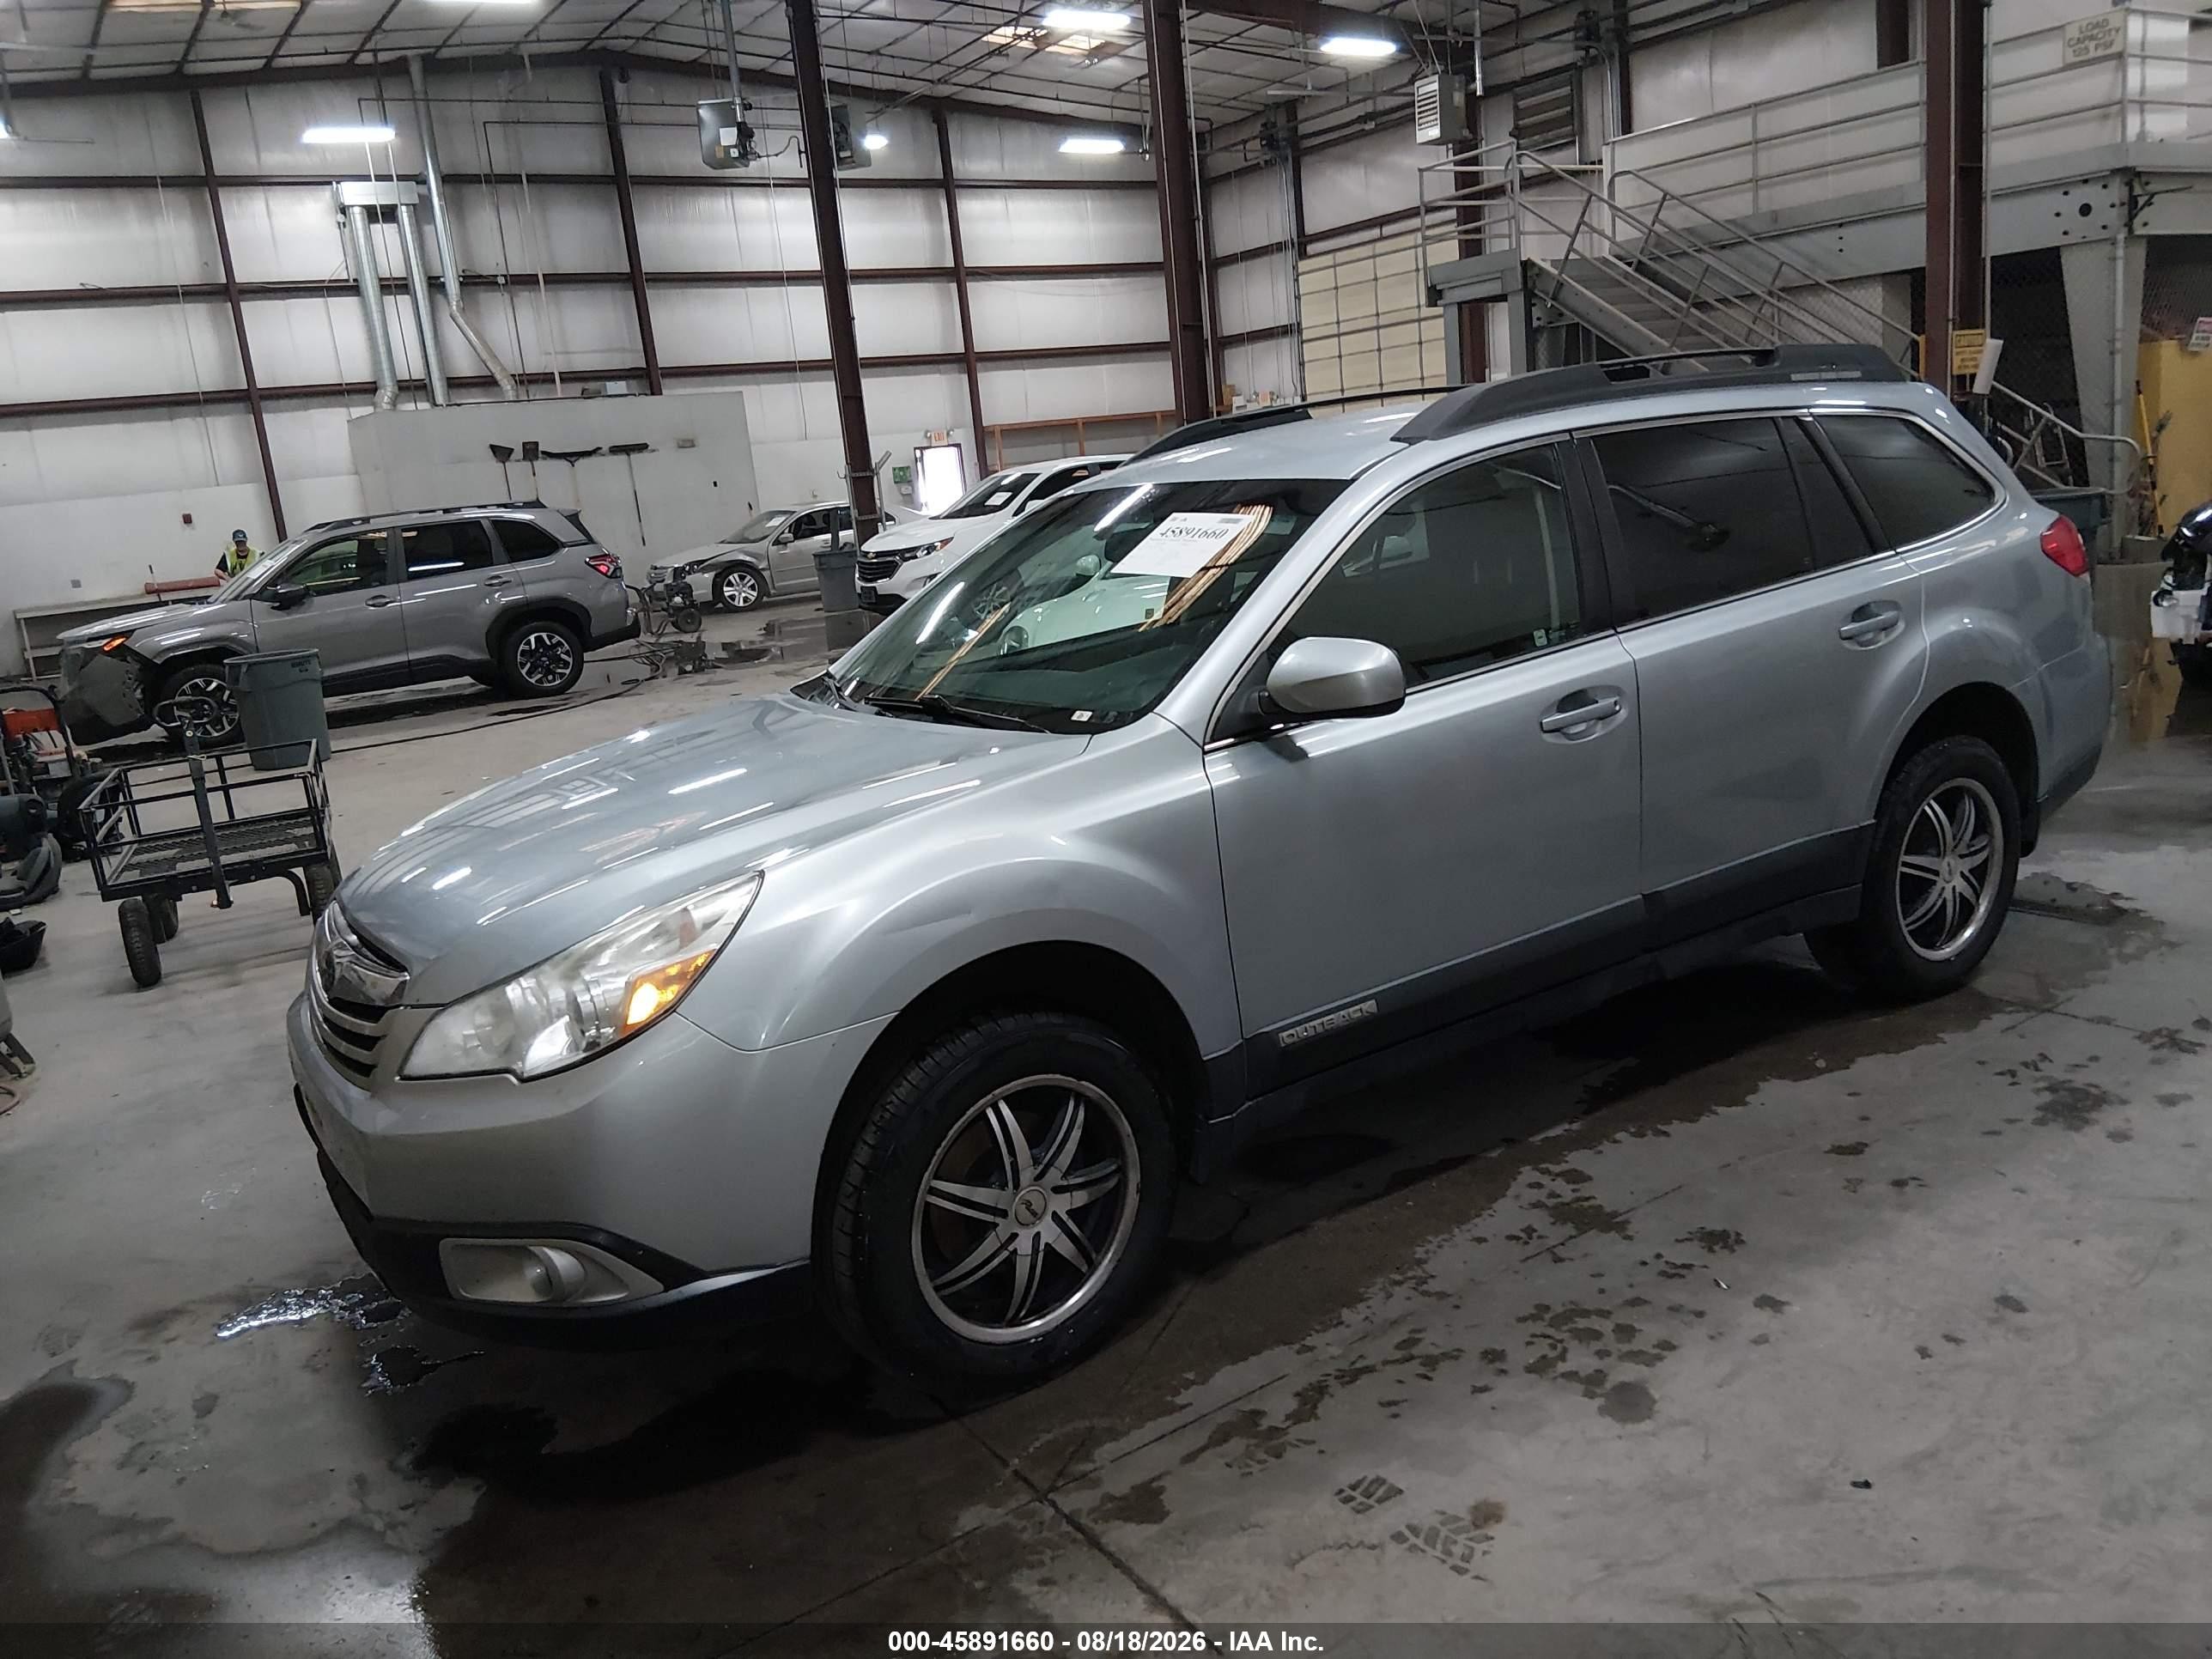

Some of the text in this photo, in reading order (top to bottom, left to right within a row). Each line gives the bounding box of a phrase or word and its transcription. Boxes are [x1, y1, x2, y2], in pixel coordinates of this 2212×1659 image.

[2079, 18, 2110, 34] LOAD
[2067, 27, 2121, 48] CAPACITY
[1159, 526, 1230, 540] 45891660
[1279, 1000, 1378, 1047] OUTBACK
